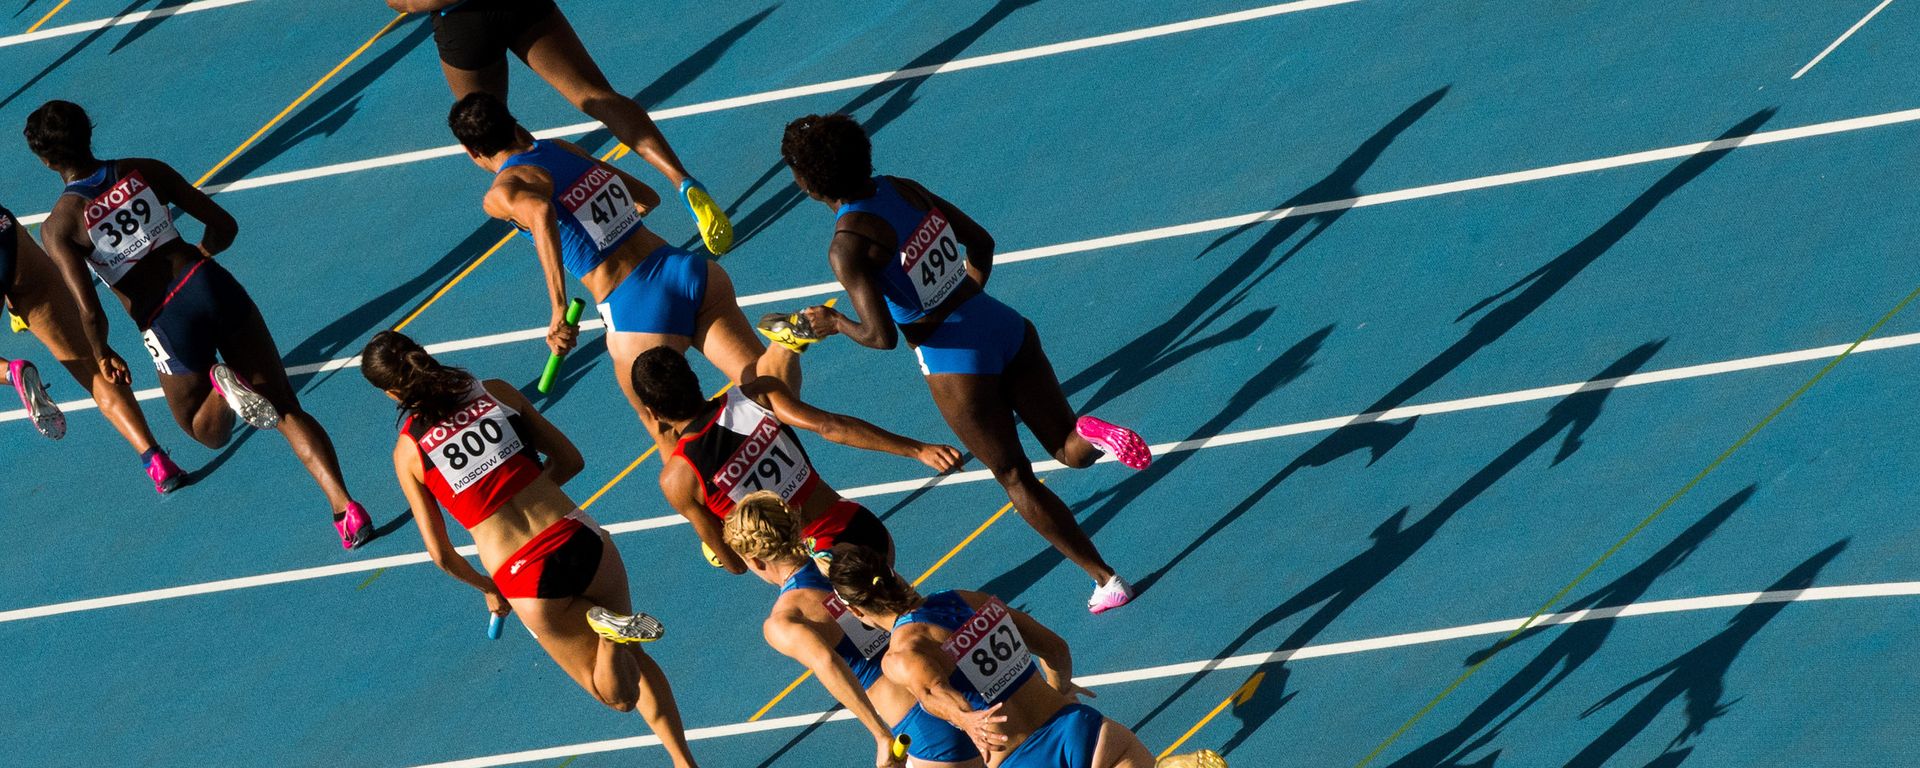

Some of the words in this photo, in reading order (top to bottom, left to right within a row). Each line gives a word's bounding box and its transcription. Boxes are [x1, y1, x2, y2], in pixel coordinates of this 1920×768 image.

[563, 168, 612, 207] TOYOTA
[590, 183, 629, 225] 479
[98, 198, 151, 248] 389
[109, 234, 151, 266] MOSCOW
[151, 221, 169, 237] 2013
[599, 213, 637, 248] MOSCOW
[921, 236, 958, 287] 490
[923, 275, 958, 307] MOSCOW
[422, 400, 492, 448] TOYOTA
[442, 418, 503, 470] 800
[454, 456, 498, 491] MOSCOW
[498, 441, 520, 460] 2013
[717, 423, 777, 487] TOYOTA
[743, 445, 796, 491] 791
[864, 631, 892, 656] MOSC
[945, 602, 1004, 657] TOYOTA
[971, 624, 1022, 677] 862
[984, 662, 1024, 700] MOSCOW
